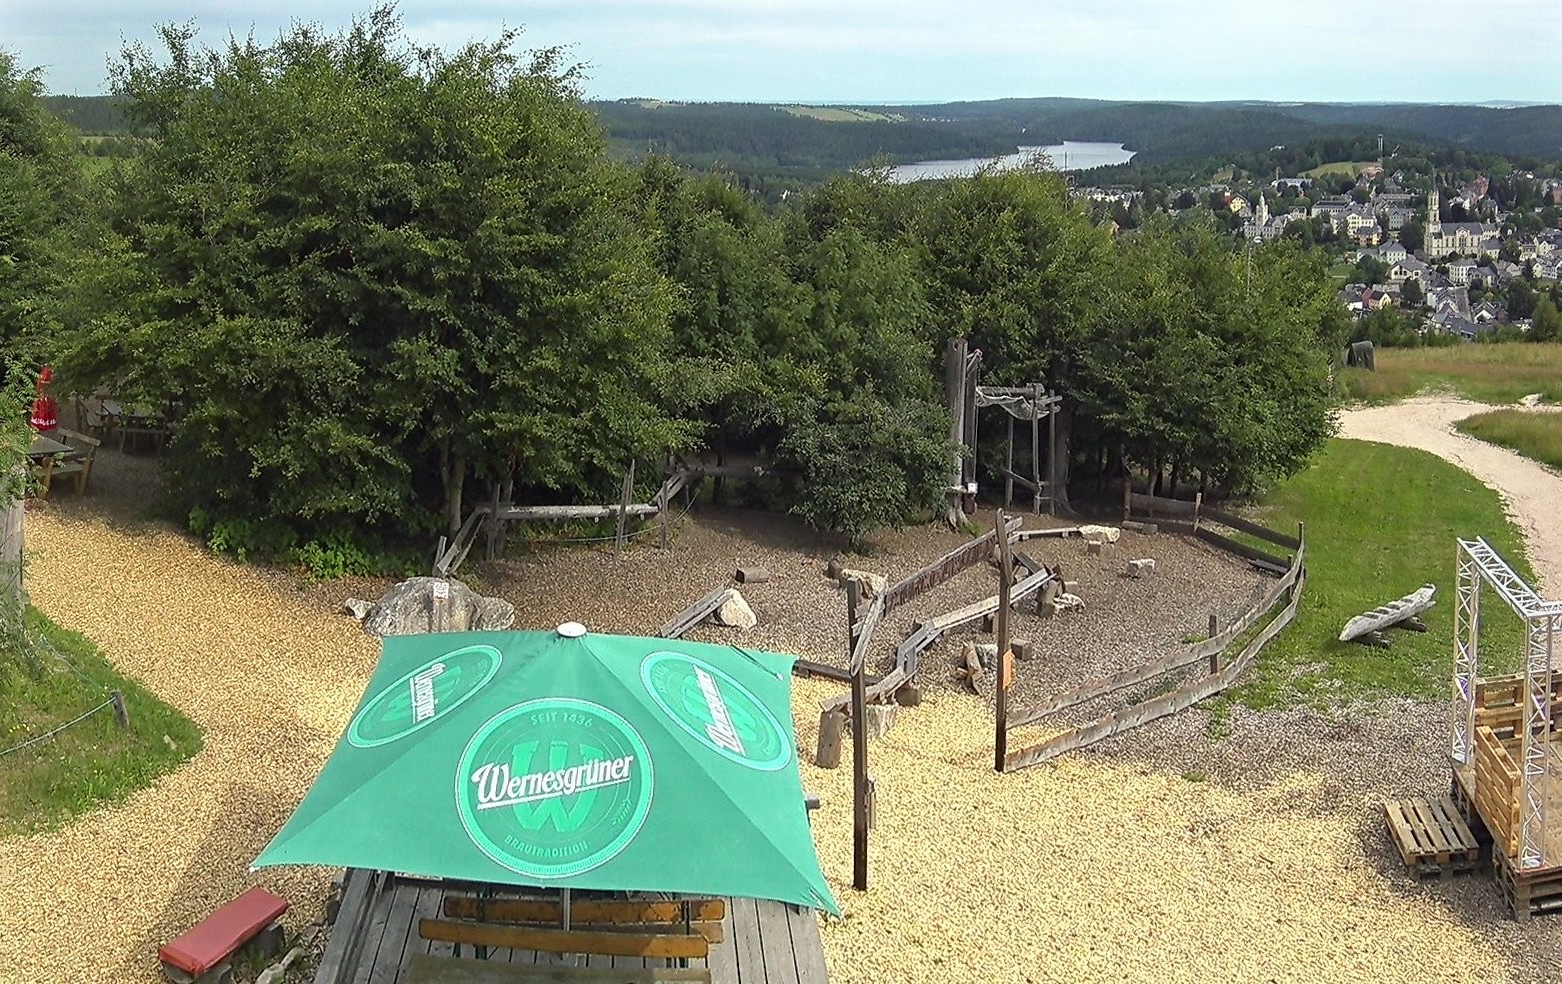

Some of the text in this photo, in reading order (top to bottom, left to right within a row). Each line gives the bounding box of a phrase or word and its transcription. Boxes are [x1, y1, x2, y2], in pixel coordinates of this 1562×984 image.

[530, 711, 594, 727] SEIT 1436
[471, 754, 634, 804] Wernesgrüner
[504, 834, 589, 859] BRAUTRADITION
